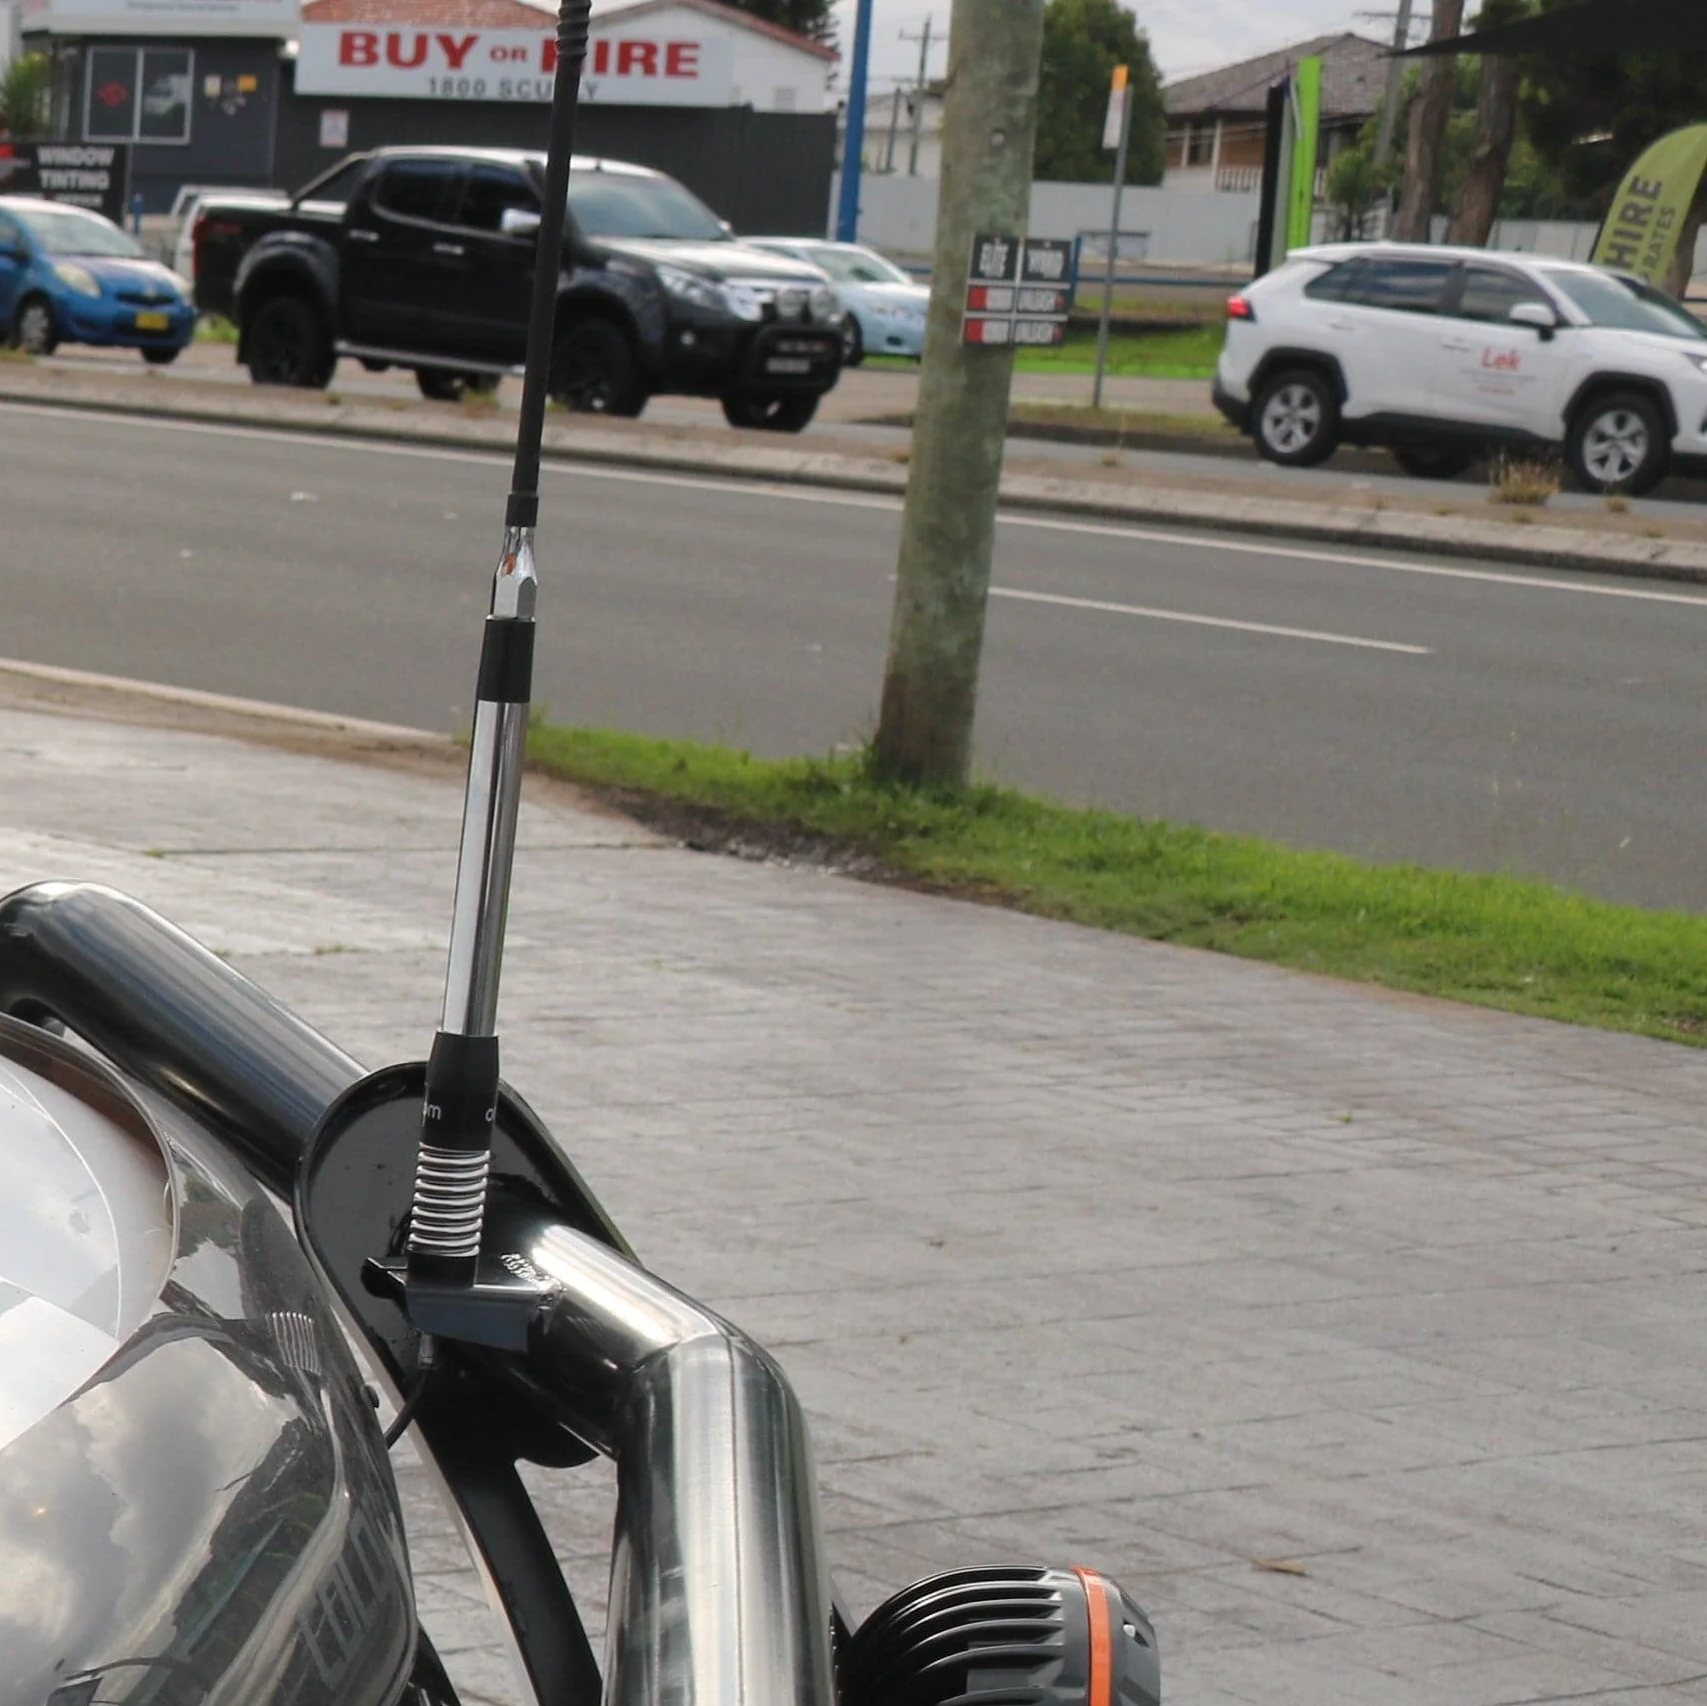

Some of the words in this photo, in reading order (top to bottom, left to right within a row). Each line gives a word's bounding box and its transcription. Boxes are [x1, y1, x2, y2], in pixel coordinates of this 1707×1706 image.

[339, 31, 479, 70] BUY
[429, 75, 487, 98] 1800
[498, 78, 601, 102] SCUY
[36, 145, 115, 167] WINDOW
[39, 168, 110, 190] TINTING
[1603, 174, 1663, 270] HIRE
